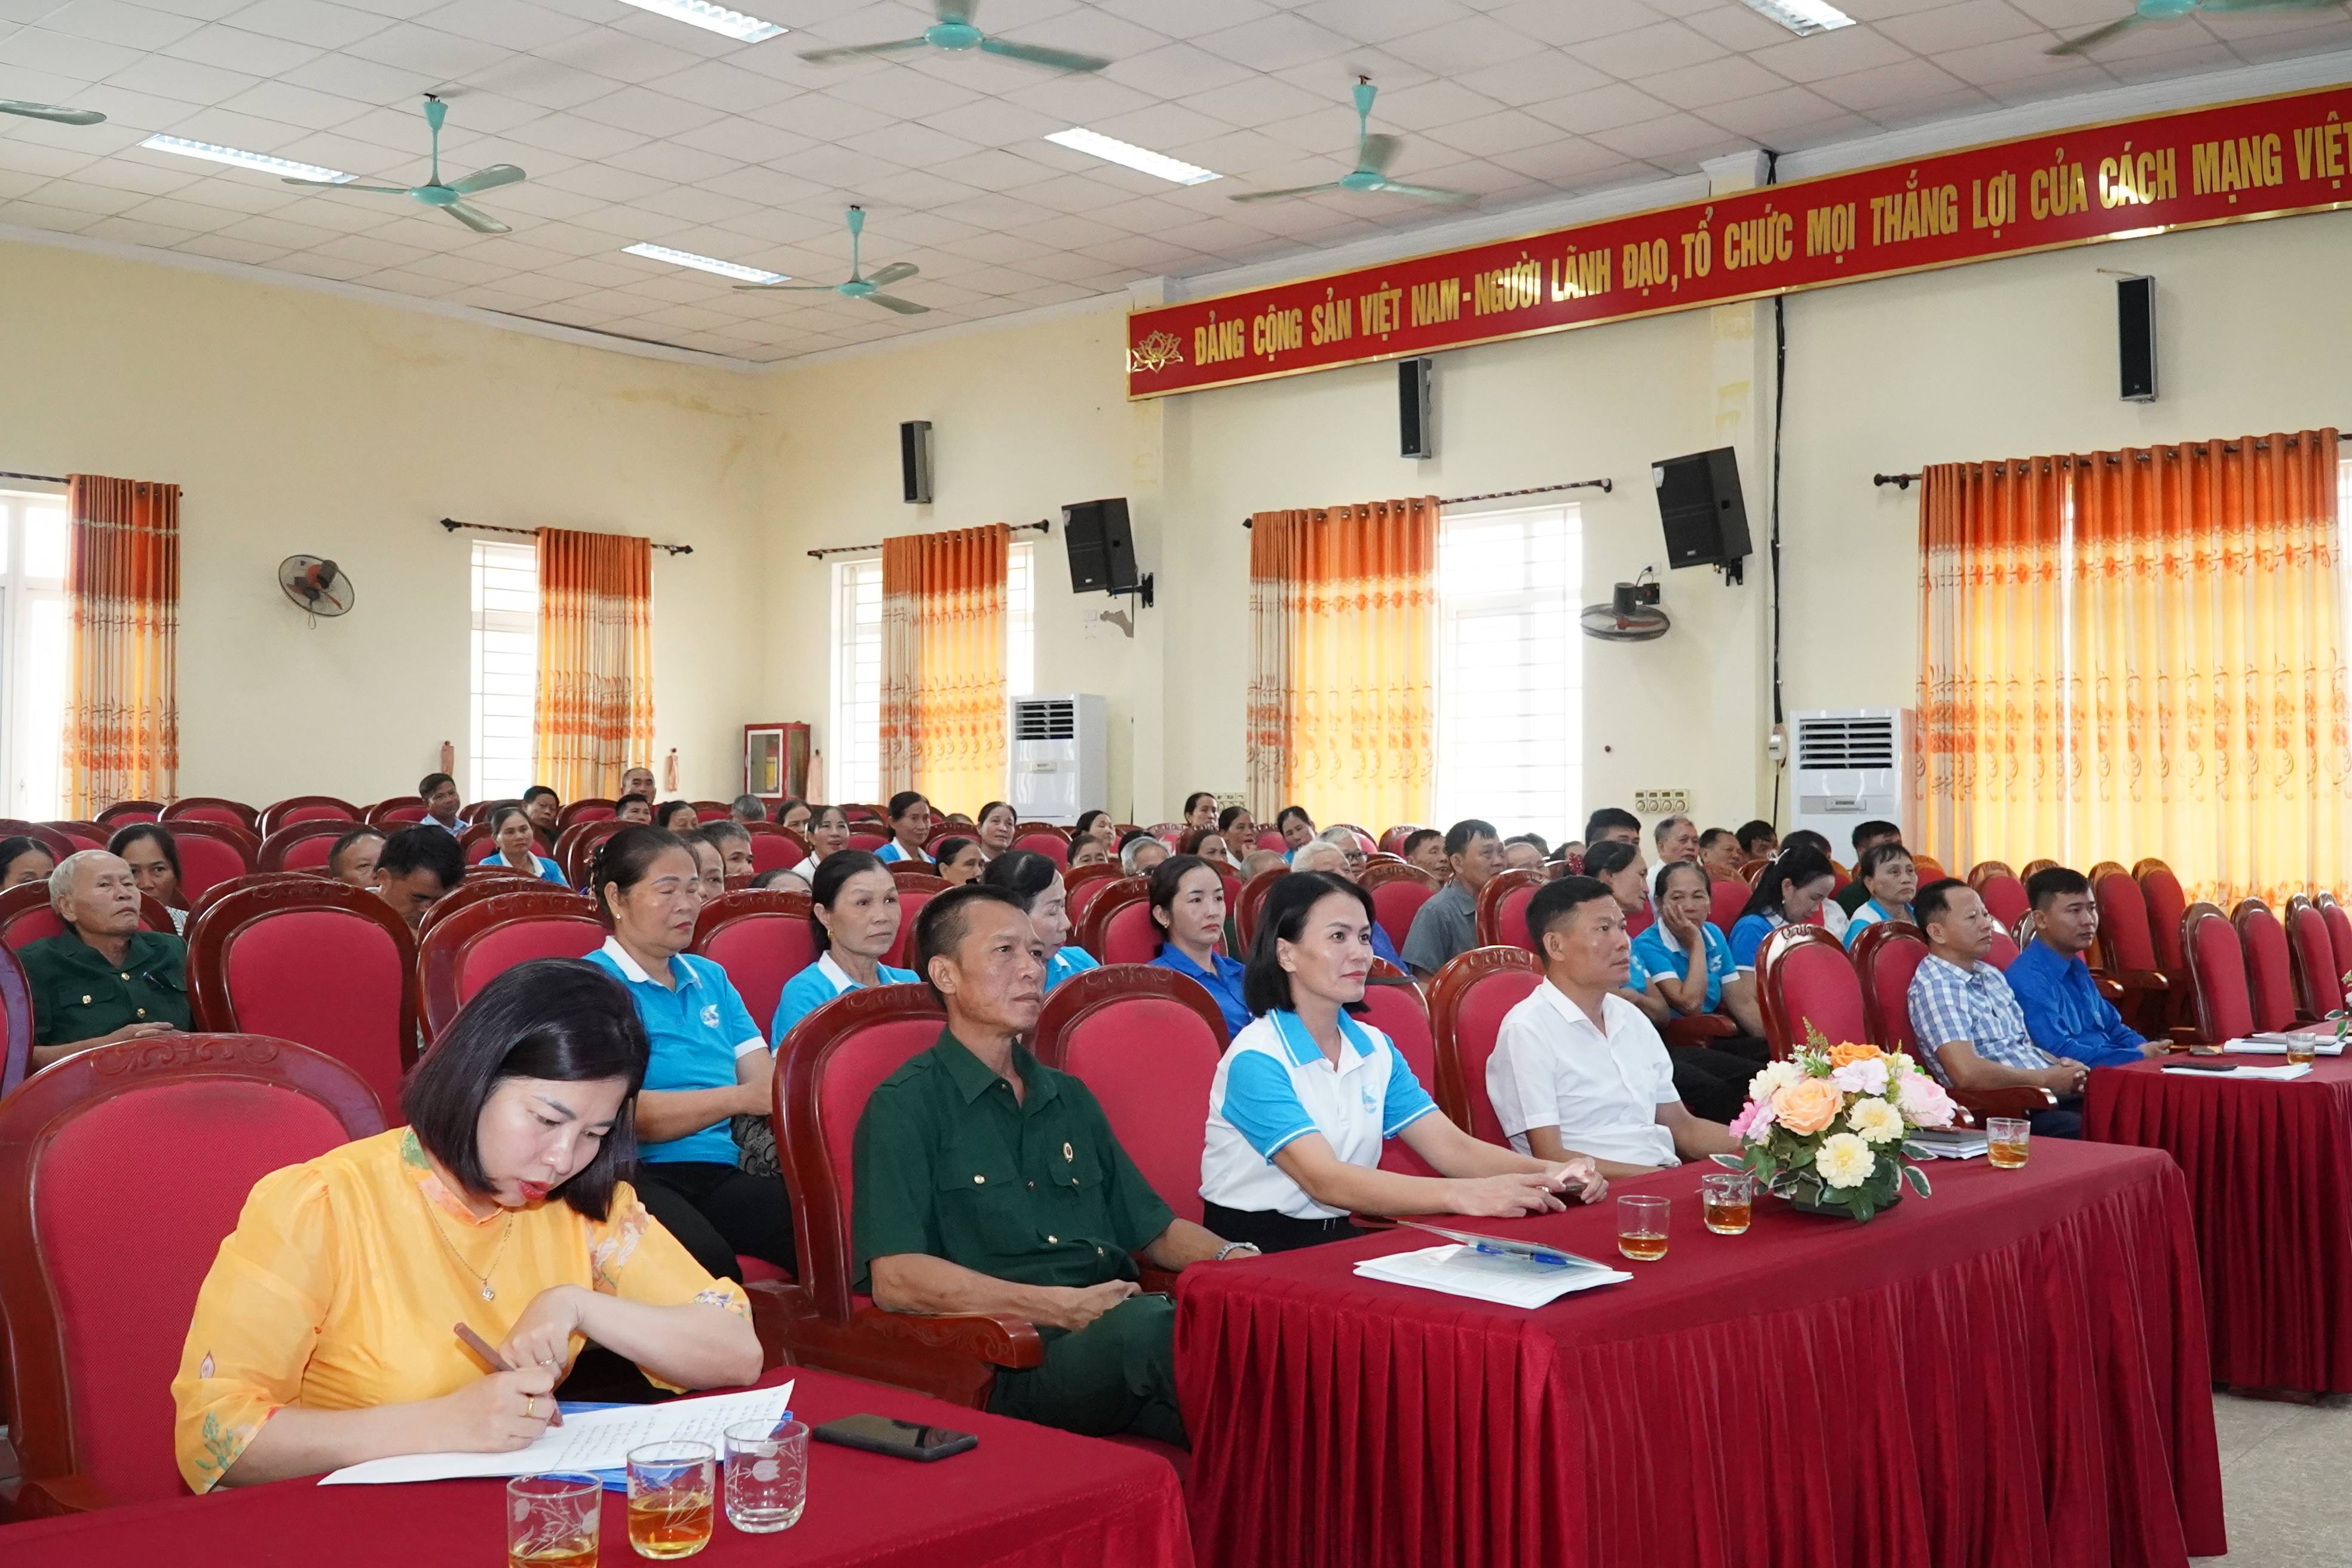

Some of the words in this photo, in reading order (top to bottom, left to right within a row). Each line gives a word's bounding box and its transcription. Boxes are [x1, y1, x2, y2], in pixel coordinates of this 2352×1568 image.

[1195, 310, 1245, 366] ĐẢNG
[1253, 304, 1303, 362] CỘNG
[1311, 287, 1352, 346] SẢN
[1359, 281, 1402, 341] VIỆT
[1551, 245, 1611, 302] LÃNH
[1724, 203, 1793, 271] CHỨC
[1806, 202, 1855, 264] MỌI
[1870, 169, 1958, 246] THẮNG
[1973, 170, 2016, 238] LỢI
[2031, 147, 2089, 220] CỦA
[2099, 140, 2177, 209] CÁCH
[2192, 133, 2283, 204] MẠNG
